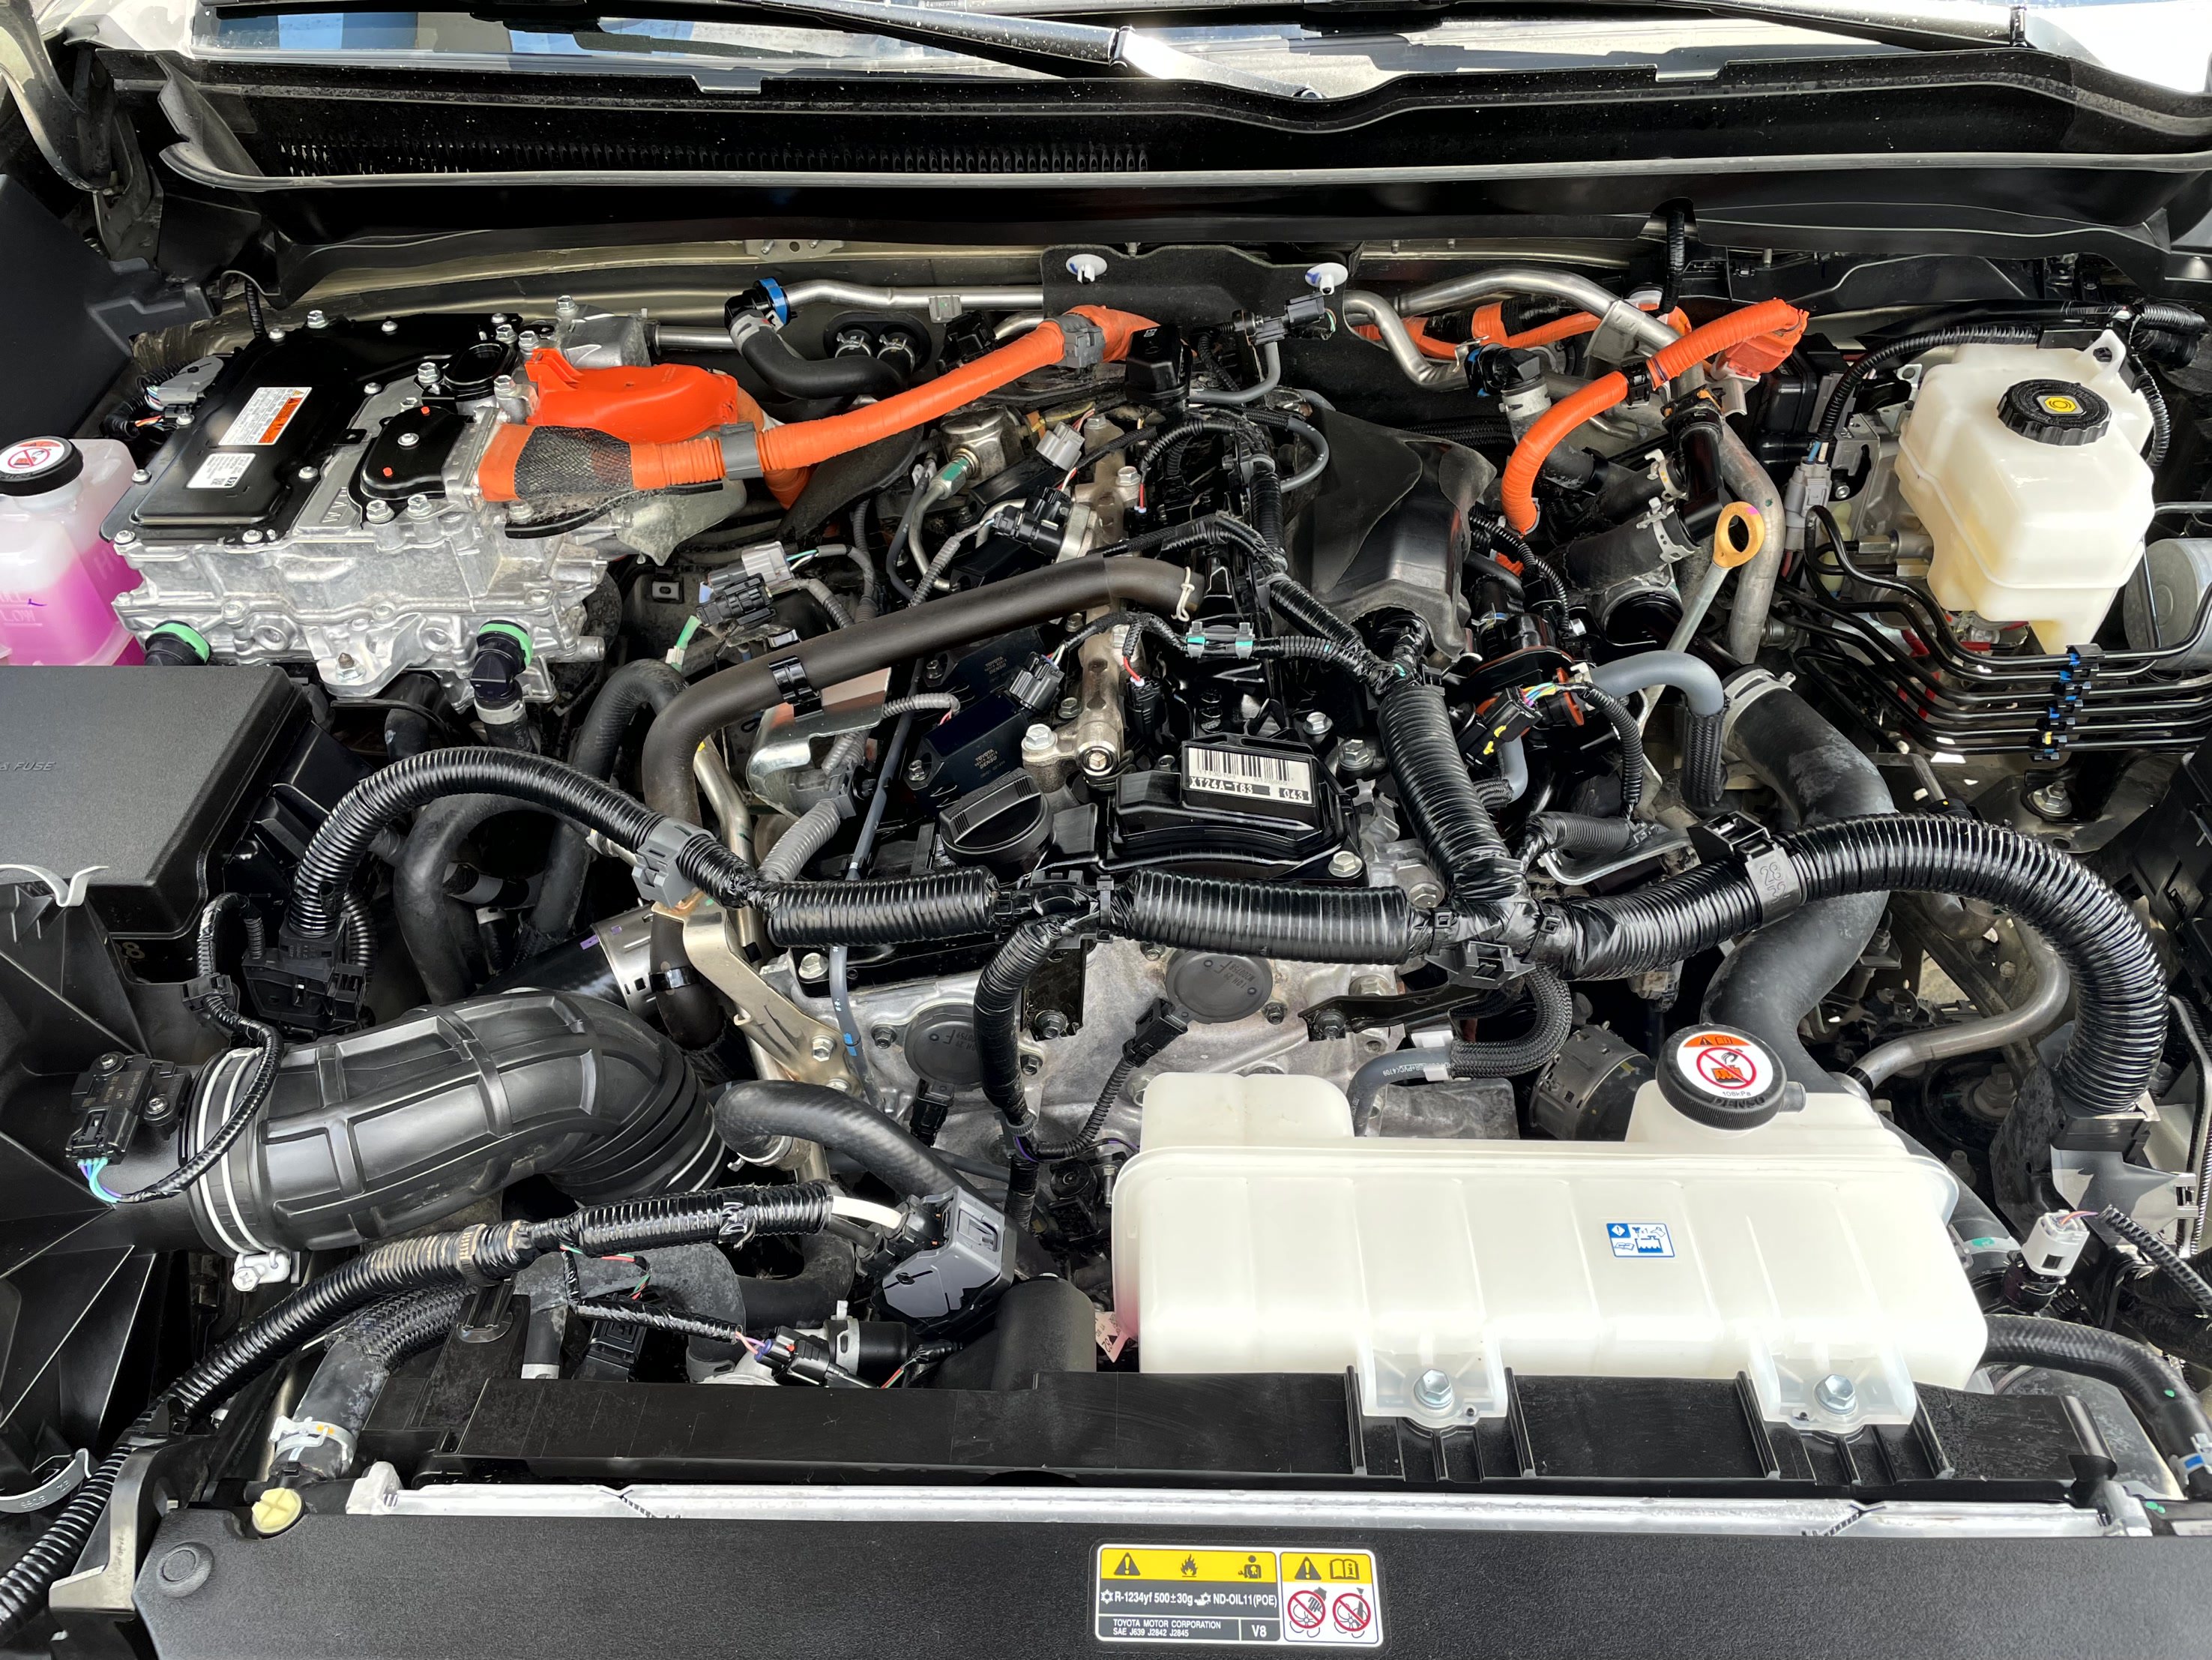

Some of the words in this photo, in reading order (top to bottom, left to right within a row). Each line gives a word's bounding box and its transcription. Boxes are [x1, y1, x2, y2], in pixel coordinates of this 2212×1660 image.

[13, 761, 57, 772] FUSE
[980, 755, 998, 769] DENSO
[1283, 790, 1304, 801] 043
[1759, 861, 1782, 886] 28
[1767, 881, 1792, 905] 32
[1714, 1095, 1765, 1109] DENSO
[1114, 1592, 1153, 1604] R-1234yf
[1154, 1593, 1193, 1606] 500±30g
[1213, 1595, 1278, 1607] ND-OIL11(POE)
[1113, 1619, 1141, 1627] TOYOTA
[1143, 1619, 1169, 1628] MOTOR
[1171, 1620, 1221, 1629] CORPORATION
[1113, 1628, 1127, 1636] SAE
[1130, 1628, 1145, 1636] J639
[1148, 1629, 1167, 1637] J2842
[1169, 1629, 1189, 1638] J2845
[1251, 1626, 1267, 1638] V8
